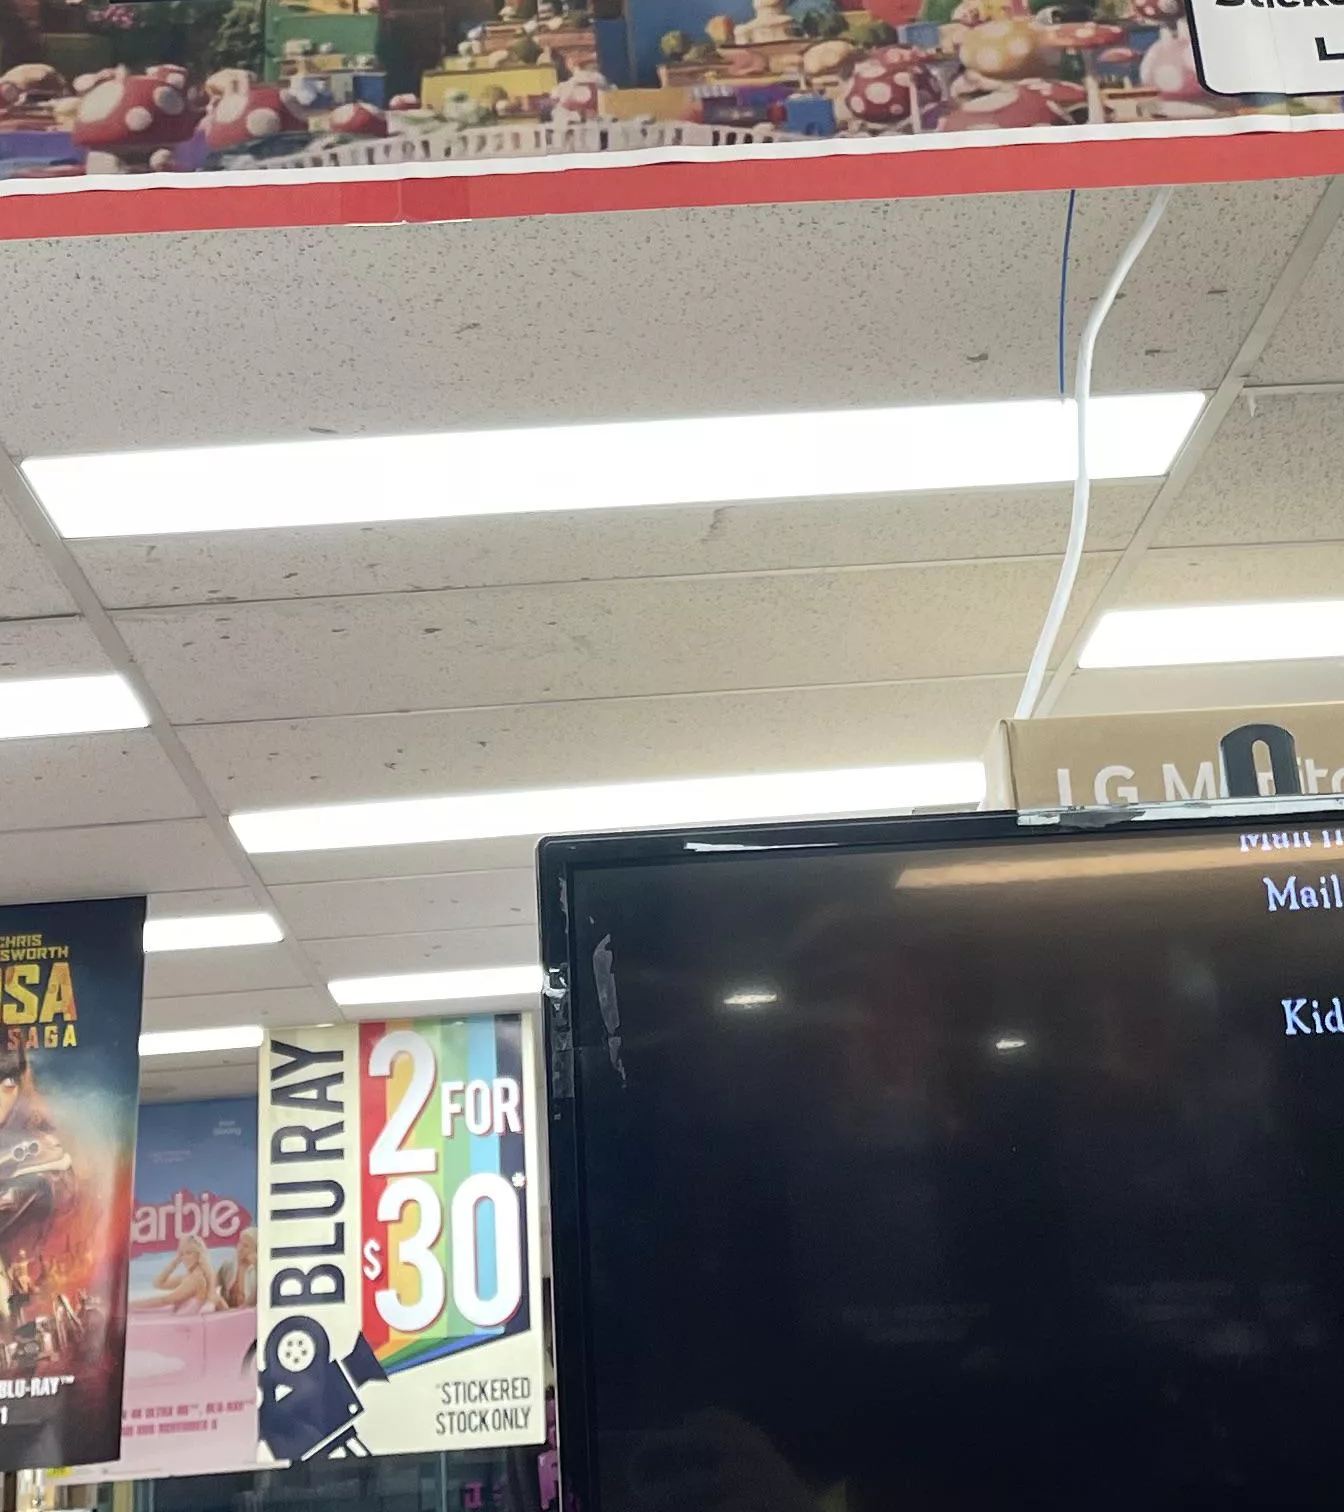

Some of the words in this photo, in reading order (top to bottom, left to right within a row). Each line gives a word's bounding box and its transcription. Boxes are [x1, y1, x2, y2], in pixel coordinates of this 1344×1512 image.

[6, 1023, 77, 1052] SAGA
[1280, 997, 1344, 1037] Kid
[269, 1039, 346, 1165] RAY
[367, 1029, 440, 1178] 2
[440, 1076, 523, 1139] FOR
[130, 1191, 241, 1244] arbie
[269, 1178, 346, 1309] BLU
[436, 1409, 490, 1435] STOCK
[491, 1406, 532, 1432] ONLY
